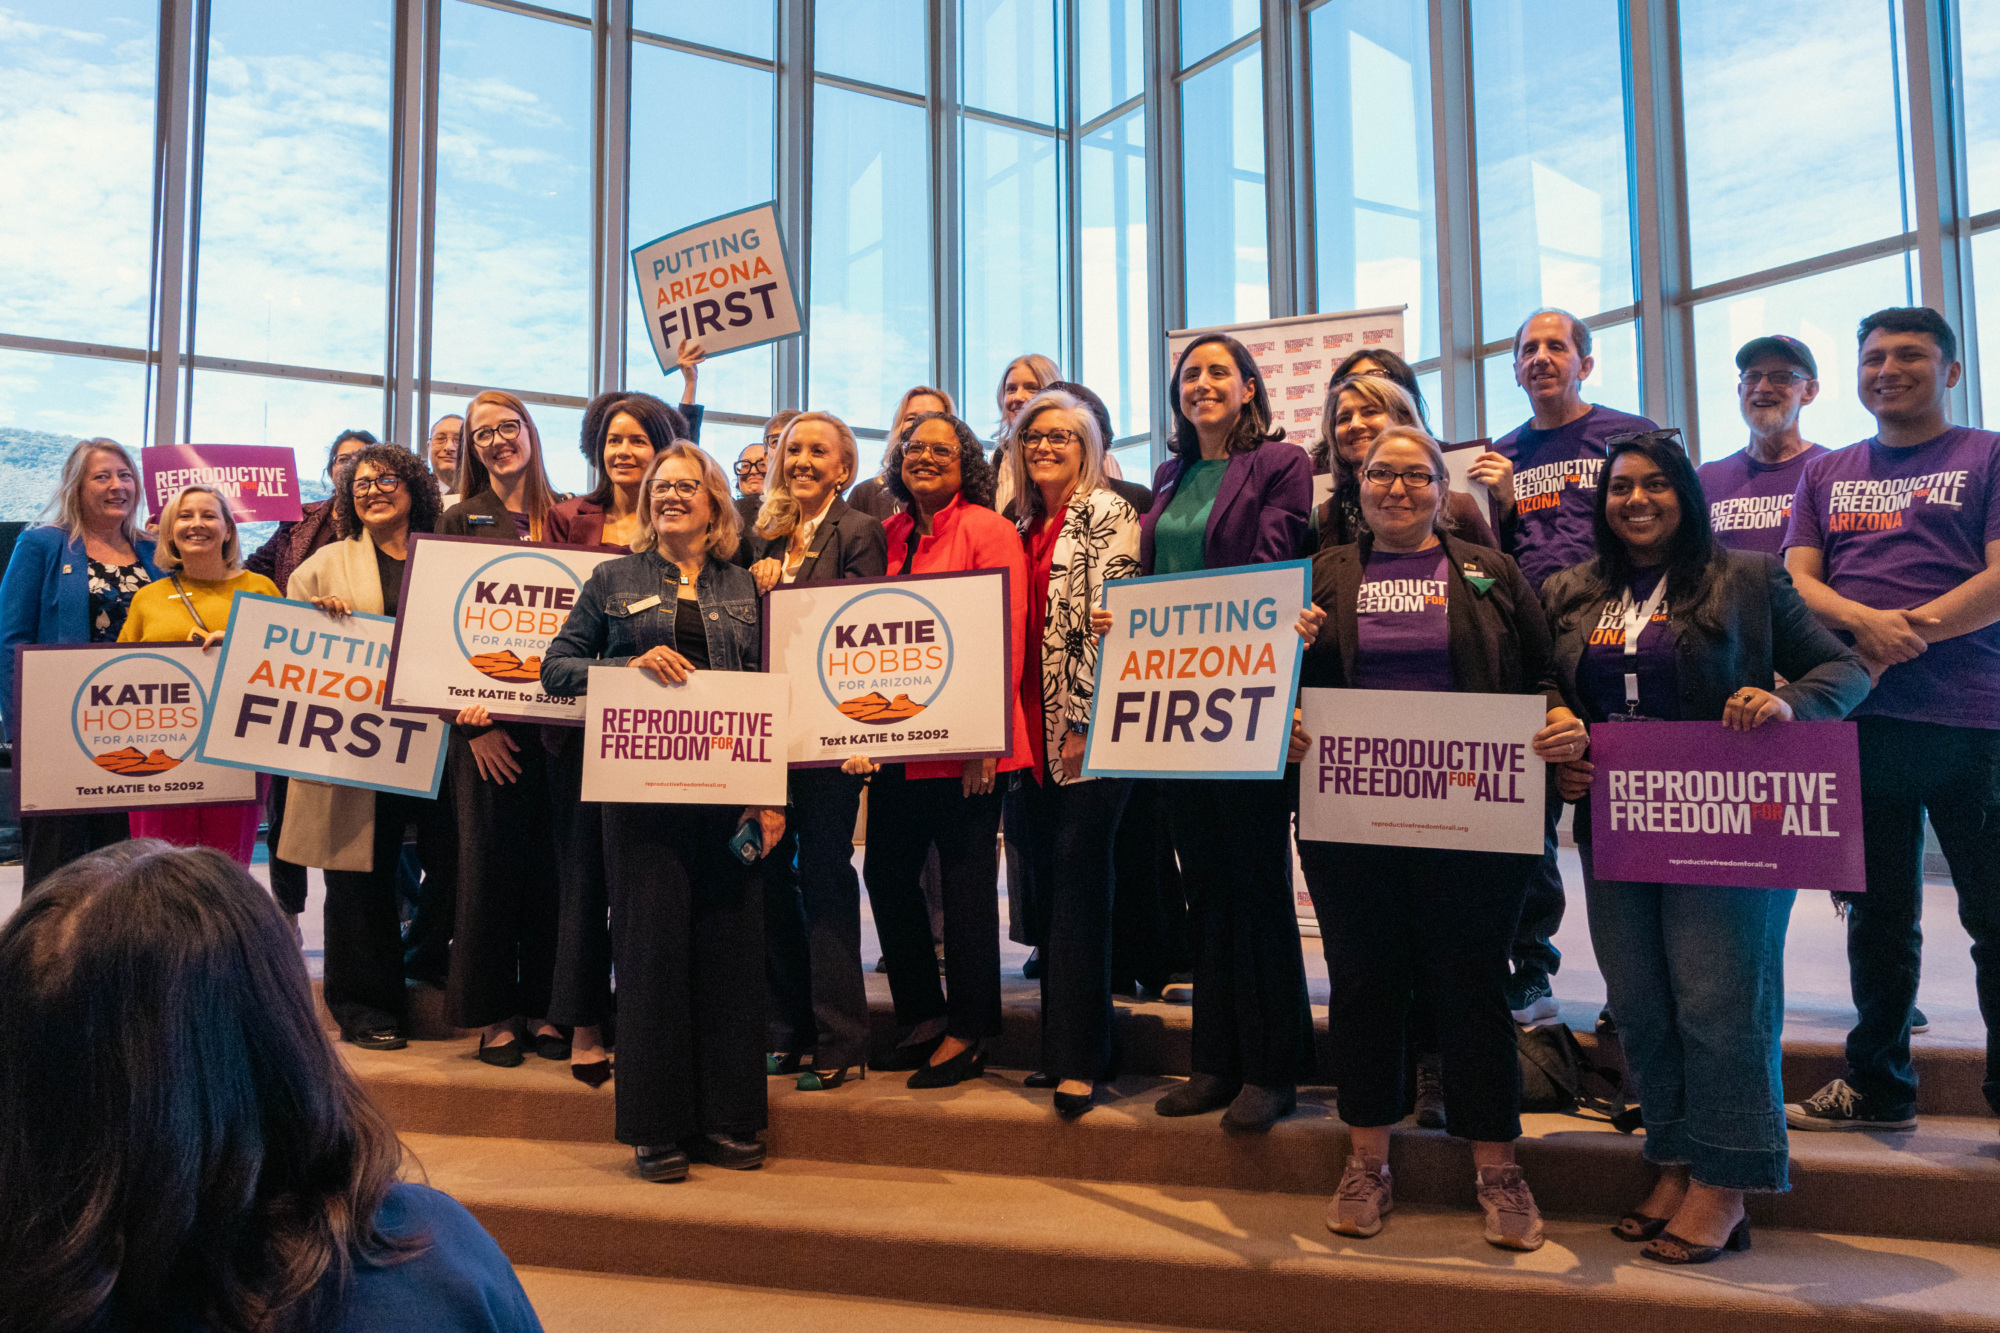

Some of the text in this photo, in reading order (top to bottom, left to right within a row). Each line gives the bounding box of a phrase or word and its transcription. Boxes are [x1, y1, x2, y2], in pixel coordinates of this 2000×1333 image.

[653, 228, 760, 280] PUTTING
[657, 256, 772, 309] ARIZONA
[659, 282, 778, 349] FIRST
[155, 467, 286, 489] REPRODUCTIVE
[1513, 459, 1606, 488] EPRODUCTIVE
[1514, 474, 1598, 500] REEDOM FOR AL
[1831, 471, 1968, 496] REPRODUCTIVE
[156, 482, 288, 506] FROM FOR ALL
[1711, 494, 1795, 518] REPRODUC
[1829, 488, 1962, 514] FREEDOM FOR ALL
[1711, 510, 1782, 532] FREEDOM
[1829, 511, 1902, 532] ARIZONA
[474, 581, 575, 610] KATIE
[1358, 580, 1448, 600] PRODUCT
[1130, 597, 1277, 638] PUTTING
[1356, 596, 1424, 614] EEDOM
[1425, 596, 1446, 606] FOR
[465, 606, 569, 634] HOBB
[836, 619, 935, 648] KATIE
[264, 624, 391, 668] PUTTIN
[472, 634, 552, 649] FOR ARIZO
[829, 646, 942, 676] HOBBS
[1120, 643, 1276, 681] ARIZONA
[91, 683, 190, 706] KATIE
[248, 660, 386, 705] ARIZO
[448, 686, 475, 698] Text
[478, 688, 516, 700] KATIE
[520, 692, 532, 702] to
[536, 694, 576, 706] 52092
[838, 676, 932, 690] FOR ARIZONA
[84, 707, 198, 732] HOBBS
[602, 708, 772, 737] REPRODUCTIVE
[1111, 686, 1276, 742] FIRST
[94, 733, 187, 744] FOR ARIZONA
[234, 693, 428, 764] FIRST
[820, 730, 949, 746] Text KATIE to 52092
[600, 734, 772, 762] FREEDOM FOR ALL
[1320, 736, 1525, 772] REPRODUCTIVE
[76, 782, 204, 796] Text KATIE to 52092
[1319, 766, 1524, 803] FREEDOM FOR ALL
[1608, 770, 1838, 804] REPRODUCTIVE
[1372, 821, 1468, 832] reproductivefreedomforall.org
[1610, 801, 1840, 836] FREEDOM FOR ALL
[1669, 858, 1778, 869] reproductivefreedomforall.org
